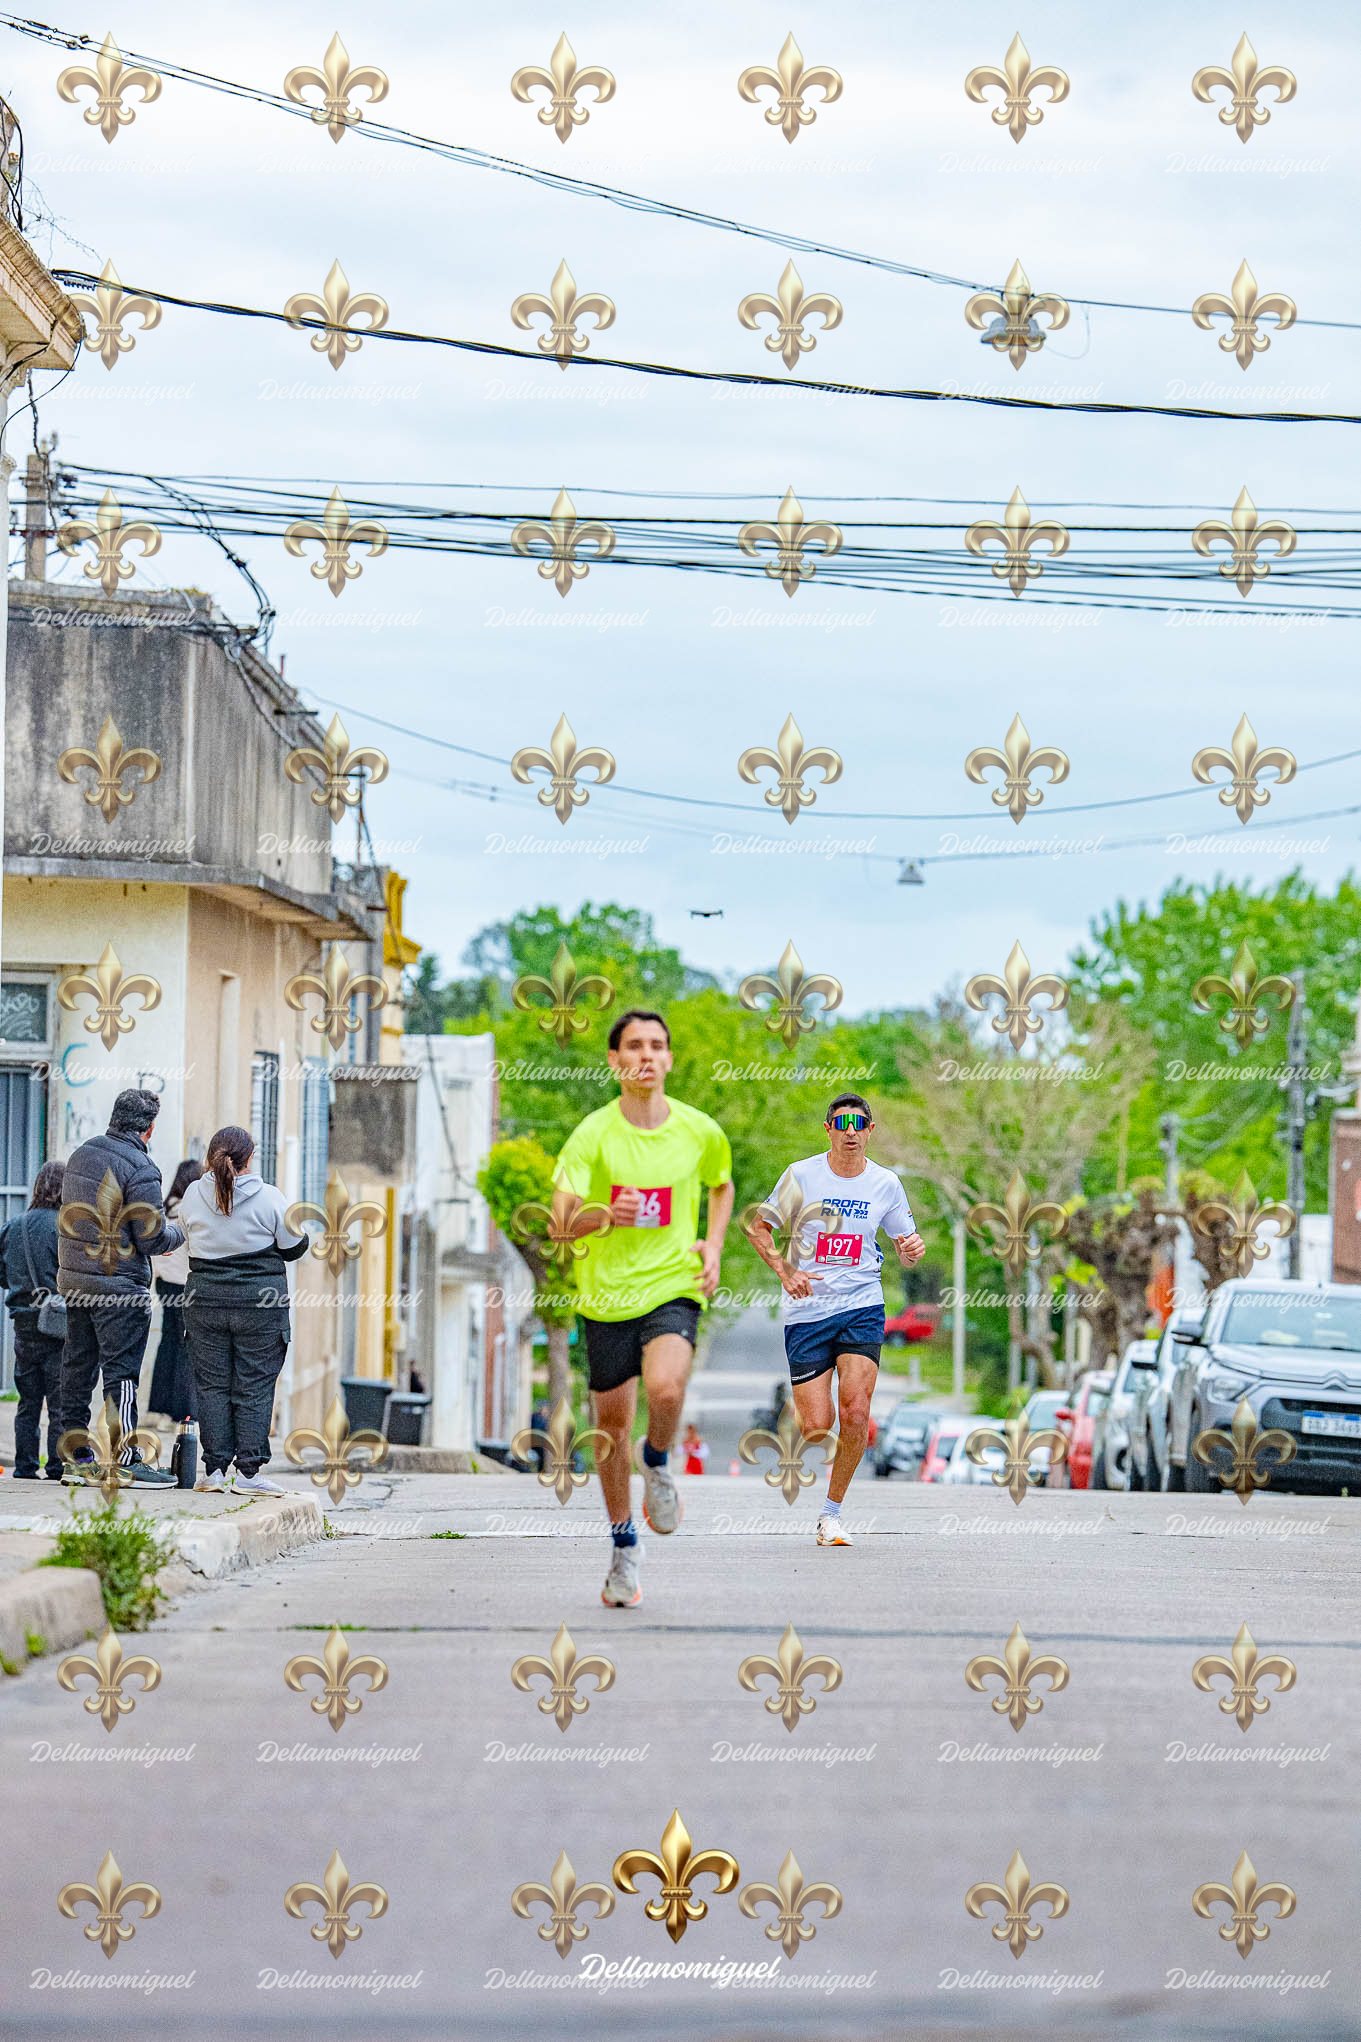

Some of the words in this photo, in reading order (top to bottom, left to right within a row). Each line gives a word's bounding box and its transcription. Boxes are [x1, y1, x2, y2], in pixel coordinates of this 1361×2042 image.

[821, 1198, 871, 1209] PROFIT
[820, 1207, 853, 1217] RUN
[826, 1237, 853, 1255] 197
